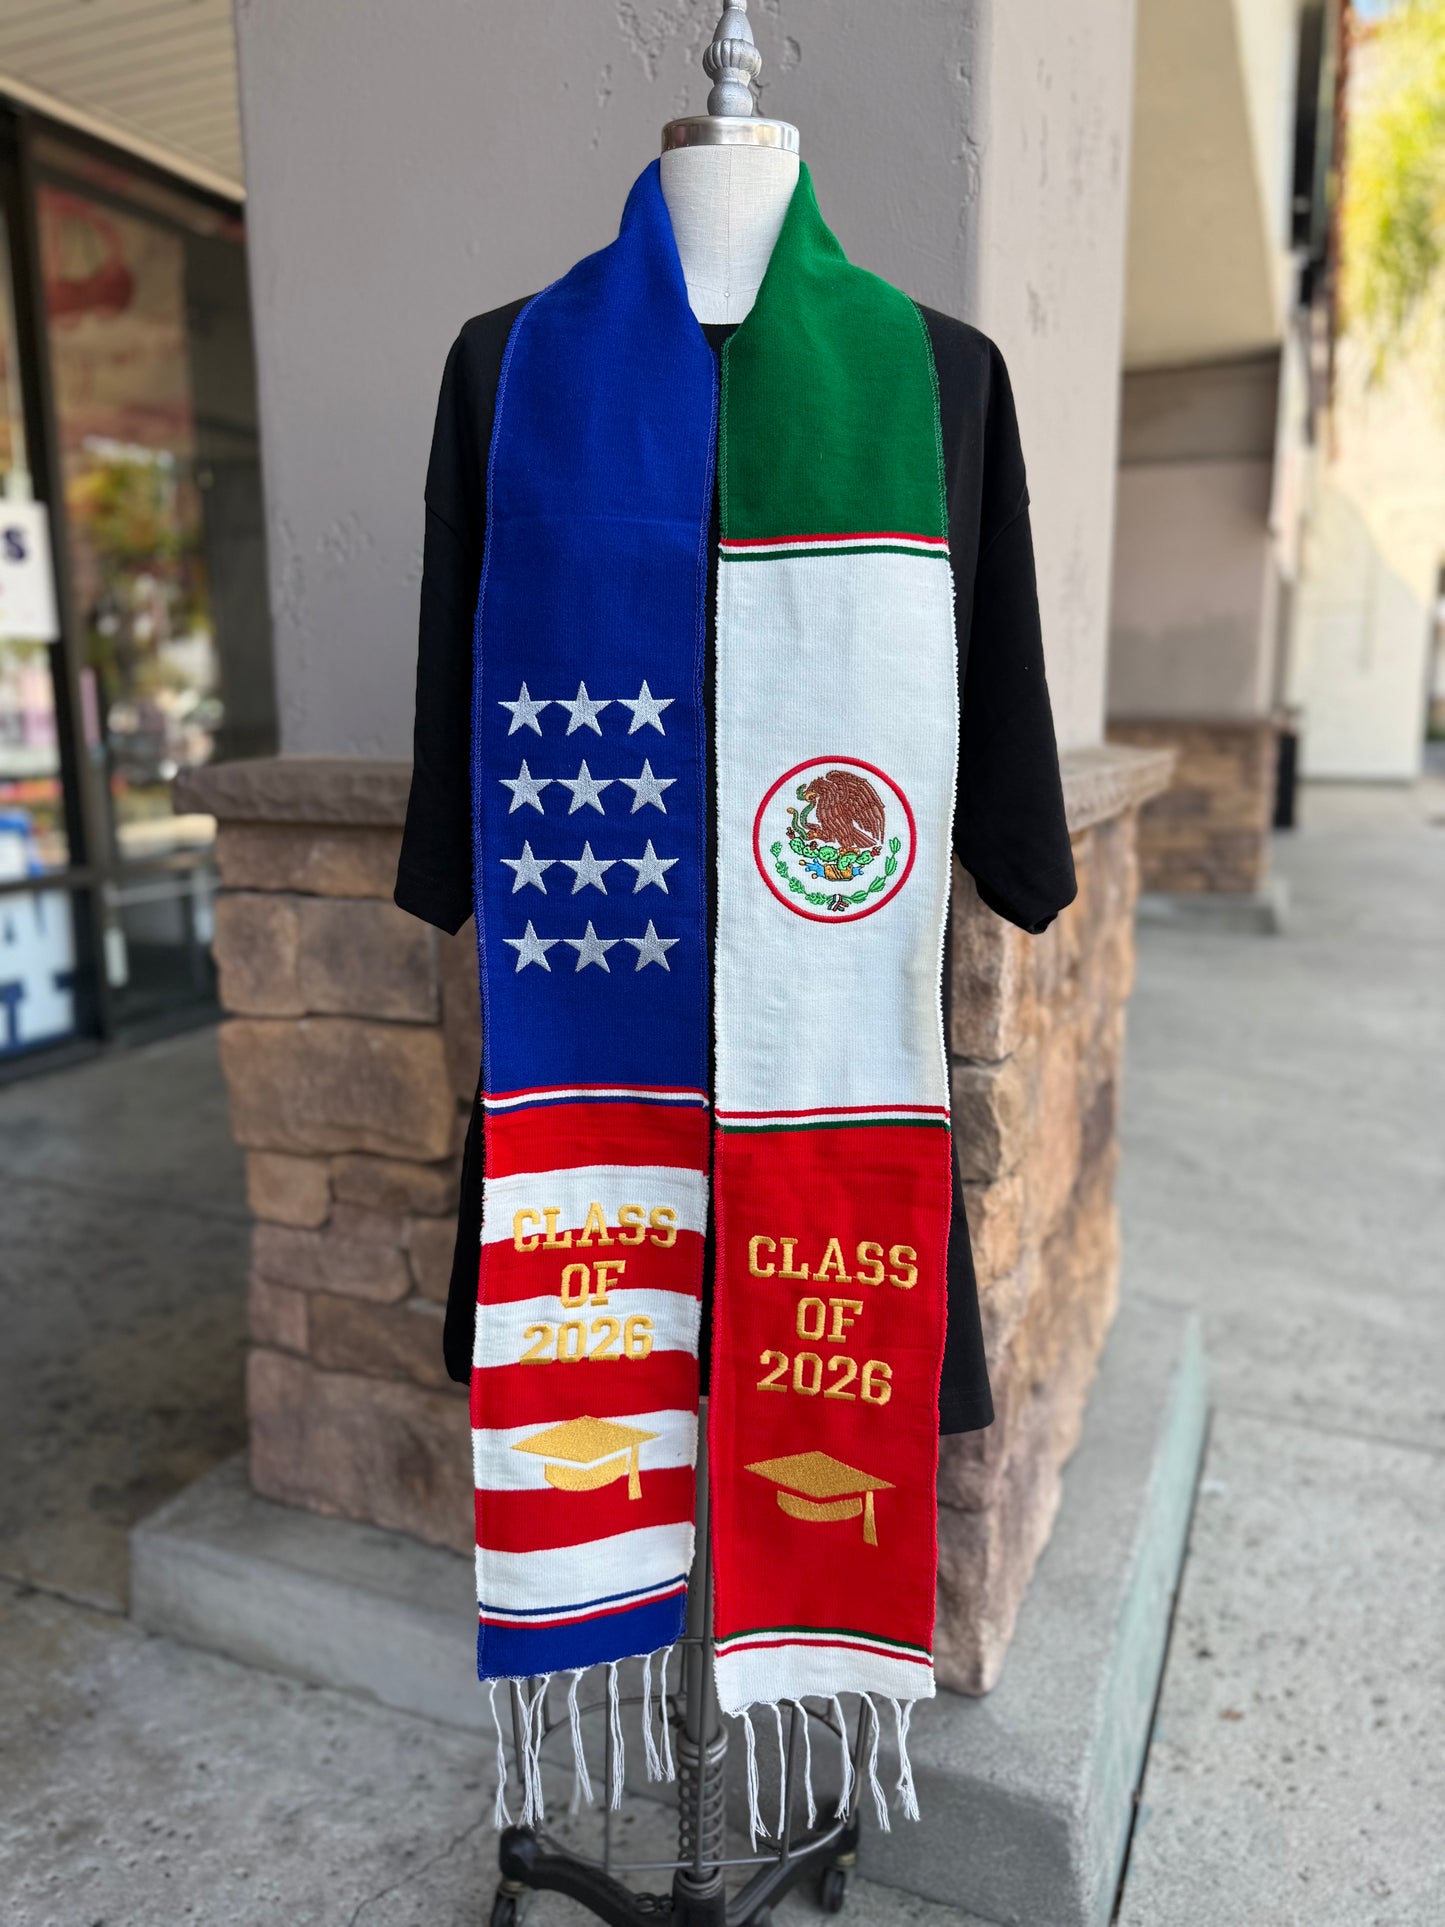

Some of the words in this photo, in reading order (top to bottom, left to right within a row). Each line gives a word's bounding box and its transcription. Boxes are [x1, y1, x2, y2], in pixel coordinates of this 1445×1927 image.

[513, 1202, 677, 1252] CLASS
[560, 1260, 626, 1308] OF
[748, 1236, 918, 1289] CLASS
[520, 1315, 653, 1366] 2026
[797, 1297, 863, 1343] OF
[757, 1350, 892, 1406] 2026
